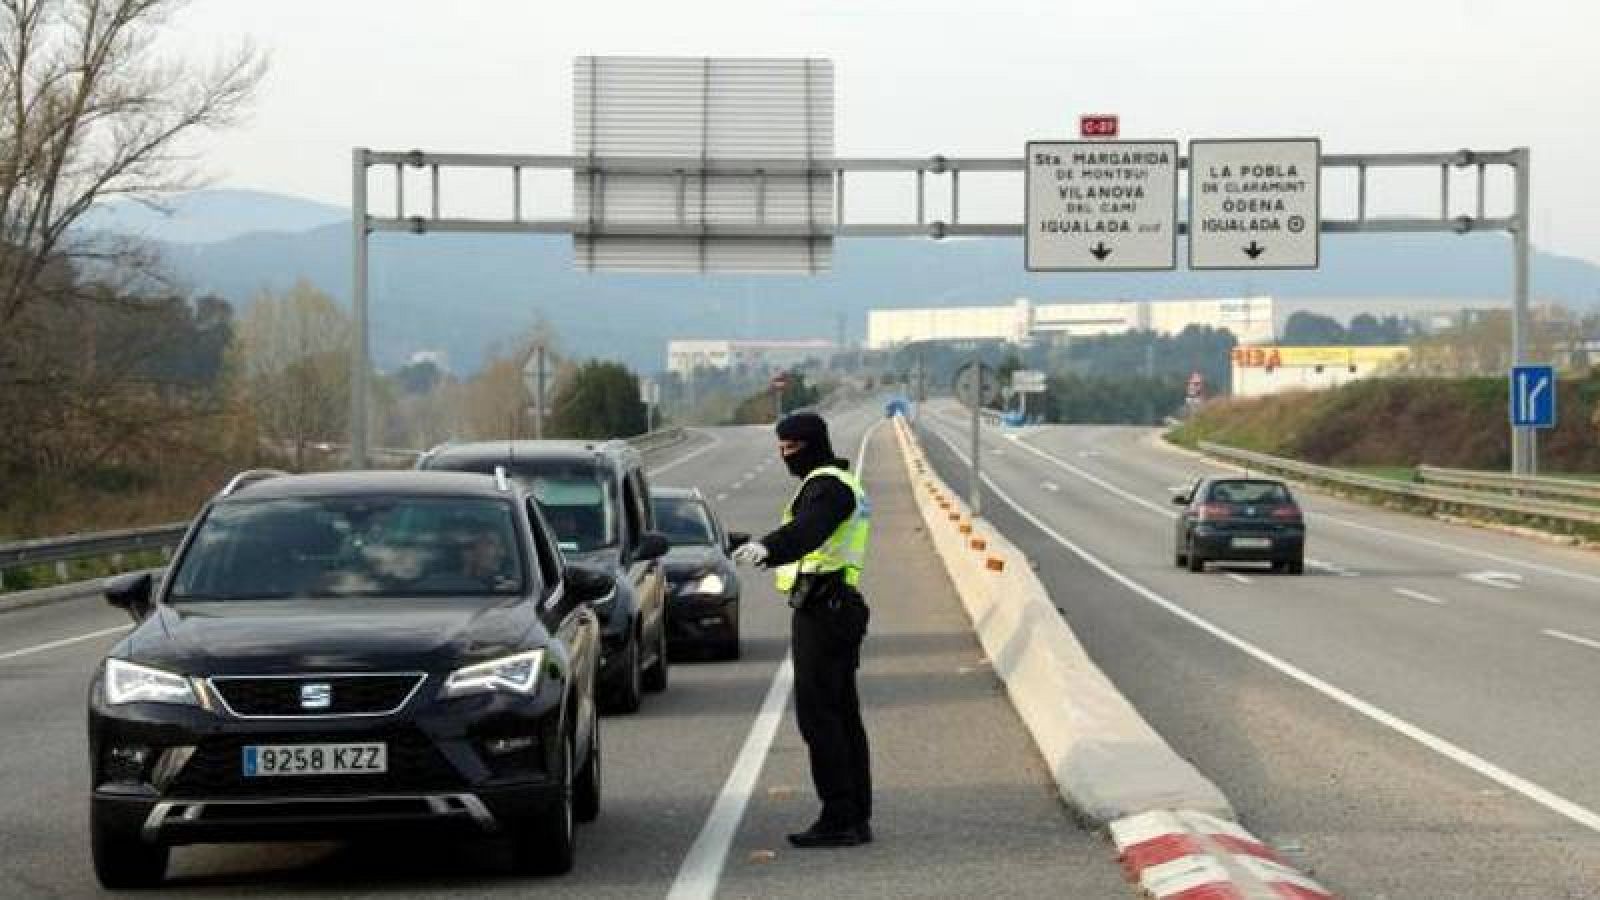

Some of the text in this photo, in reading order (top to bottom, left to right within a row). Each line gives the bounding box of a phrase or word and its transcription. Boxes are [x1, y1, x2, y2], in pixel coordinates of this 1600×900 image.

[1073, 152, 1169, 165] MARGARIDA
[1056, 169, 1073, 181] DE
[1209, 165, 1298, 178] LA POBLA
[1058, 185, 1145, 200] VILANOVA
[1201, 180, 1307, 193] DE CLARAMUNT
[1066, 202, 1092, 213] DEL
[1040, 218, 1130, 233] IGUALADA
[1201, 217, 1281, 233] IGUALADA
[262, 746, 381, 771] 9258 KZZ
